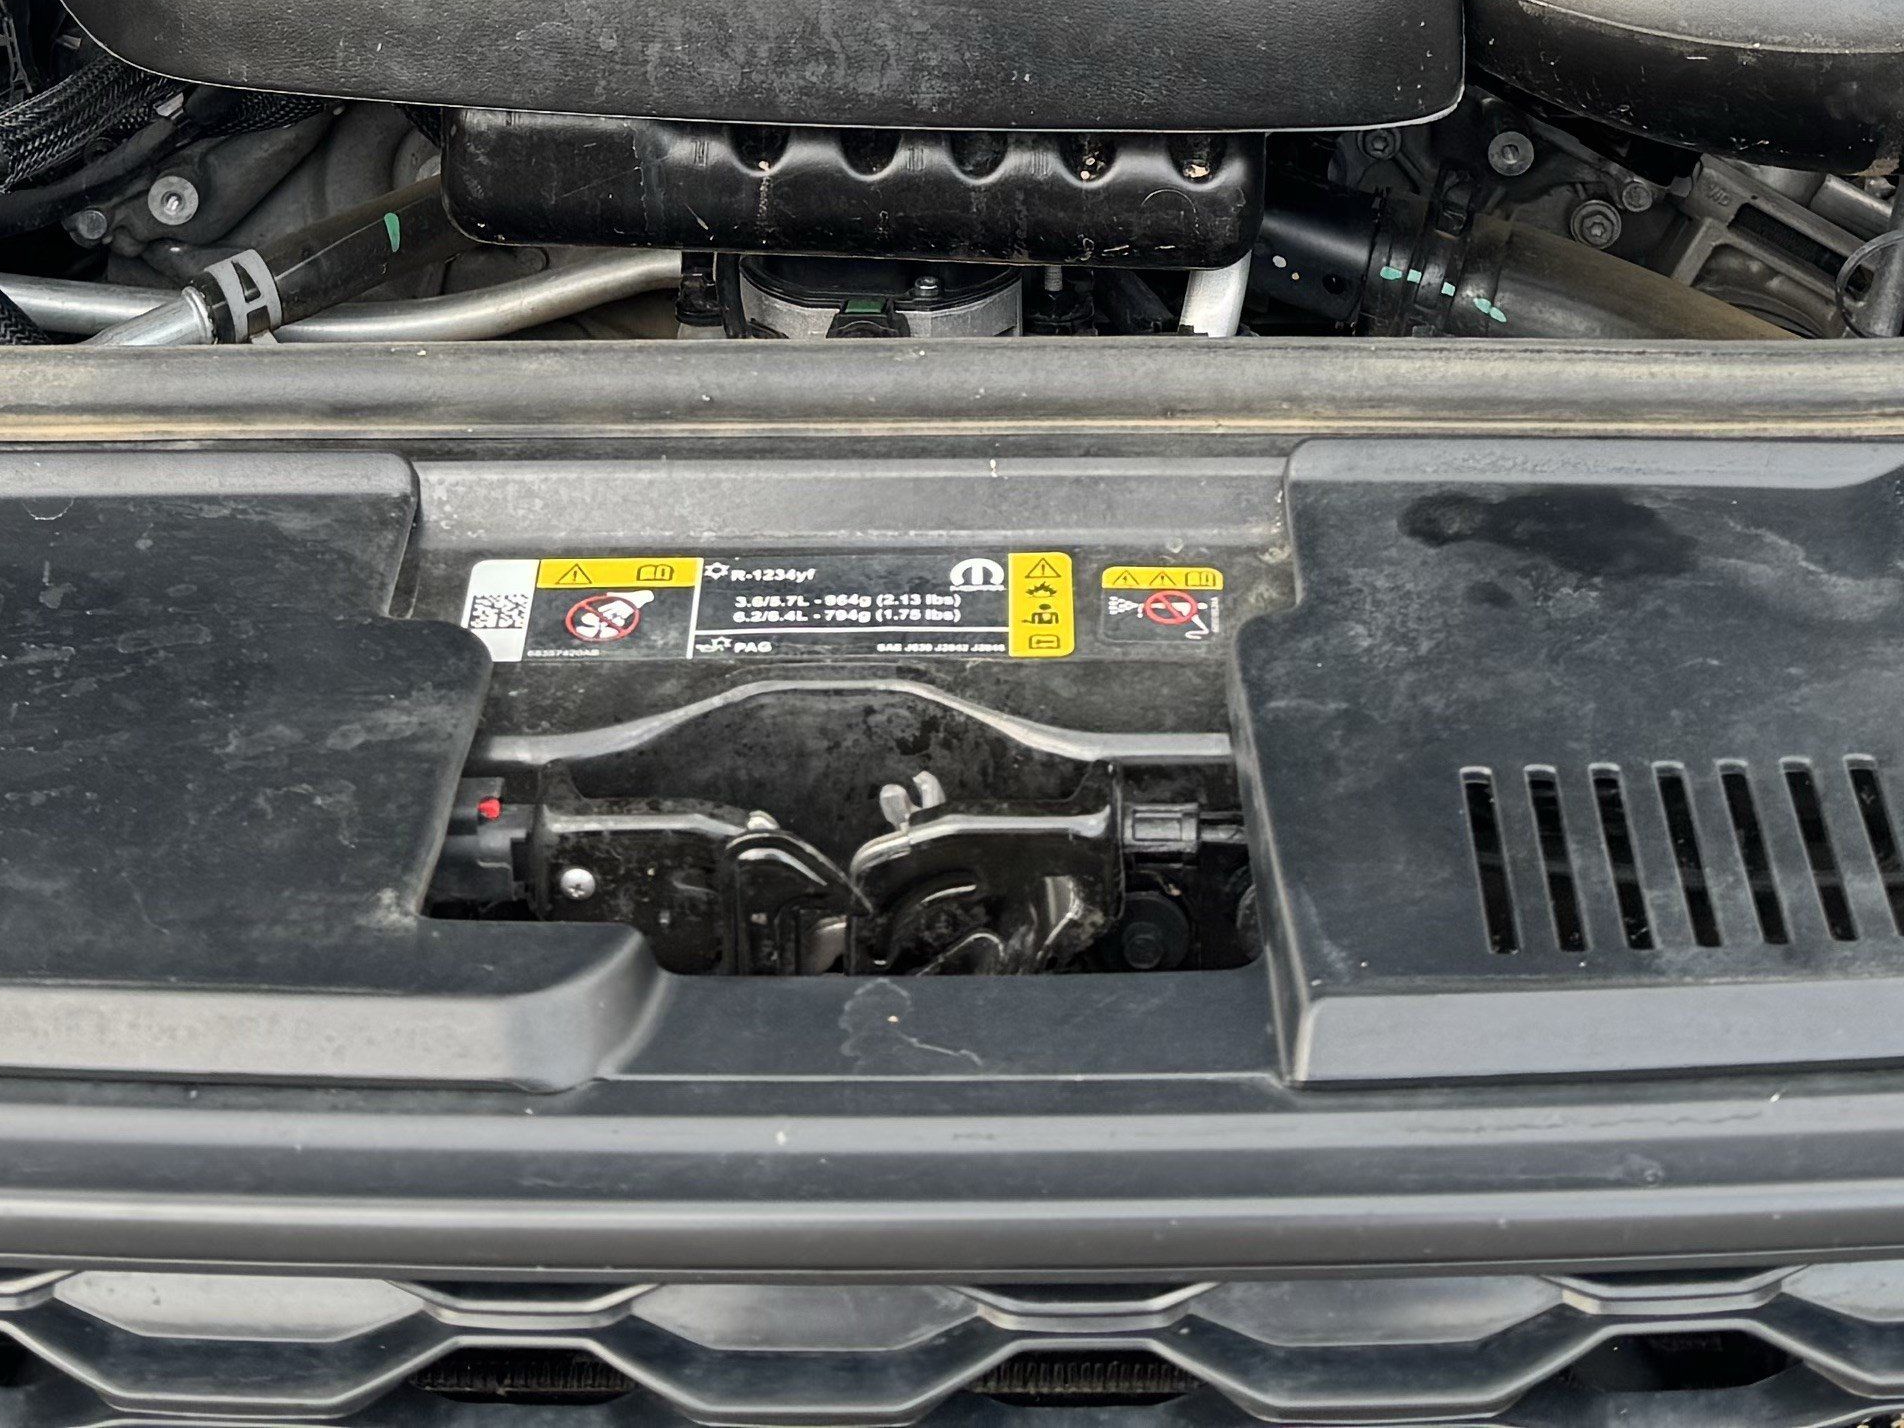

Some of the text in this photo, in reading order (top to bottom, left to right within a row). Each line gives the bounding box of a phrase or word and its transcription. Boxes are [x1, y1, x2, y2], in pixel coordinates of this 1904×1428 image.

[730, 568, 816, 583] R-1234yf
[875, 593, 922, 607] (2.13
[925, 593, 962, 607] lbs)
[924, 608, 962, 623] lbs)
[734, 641, 773, 653] PAG
